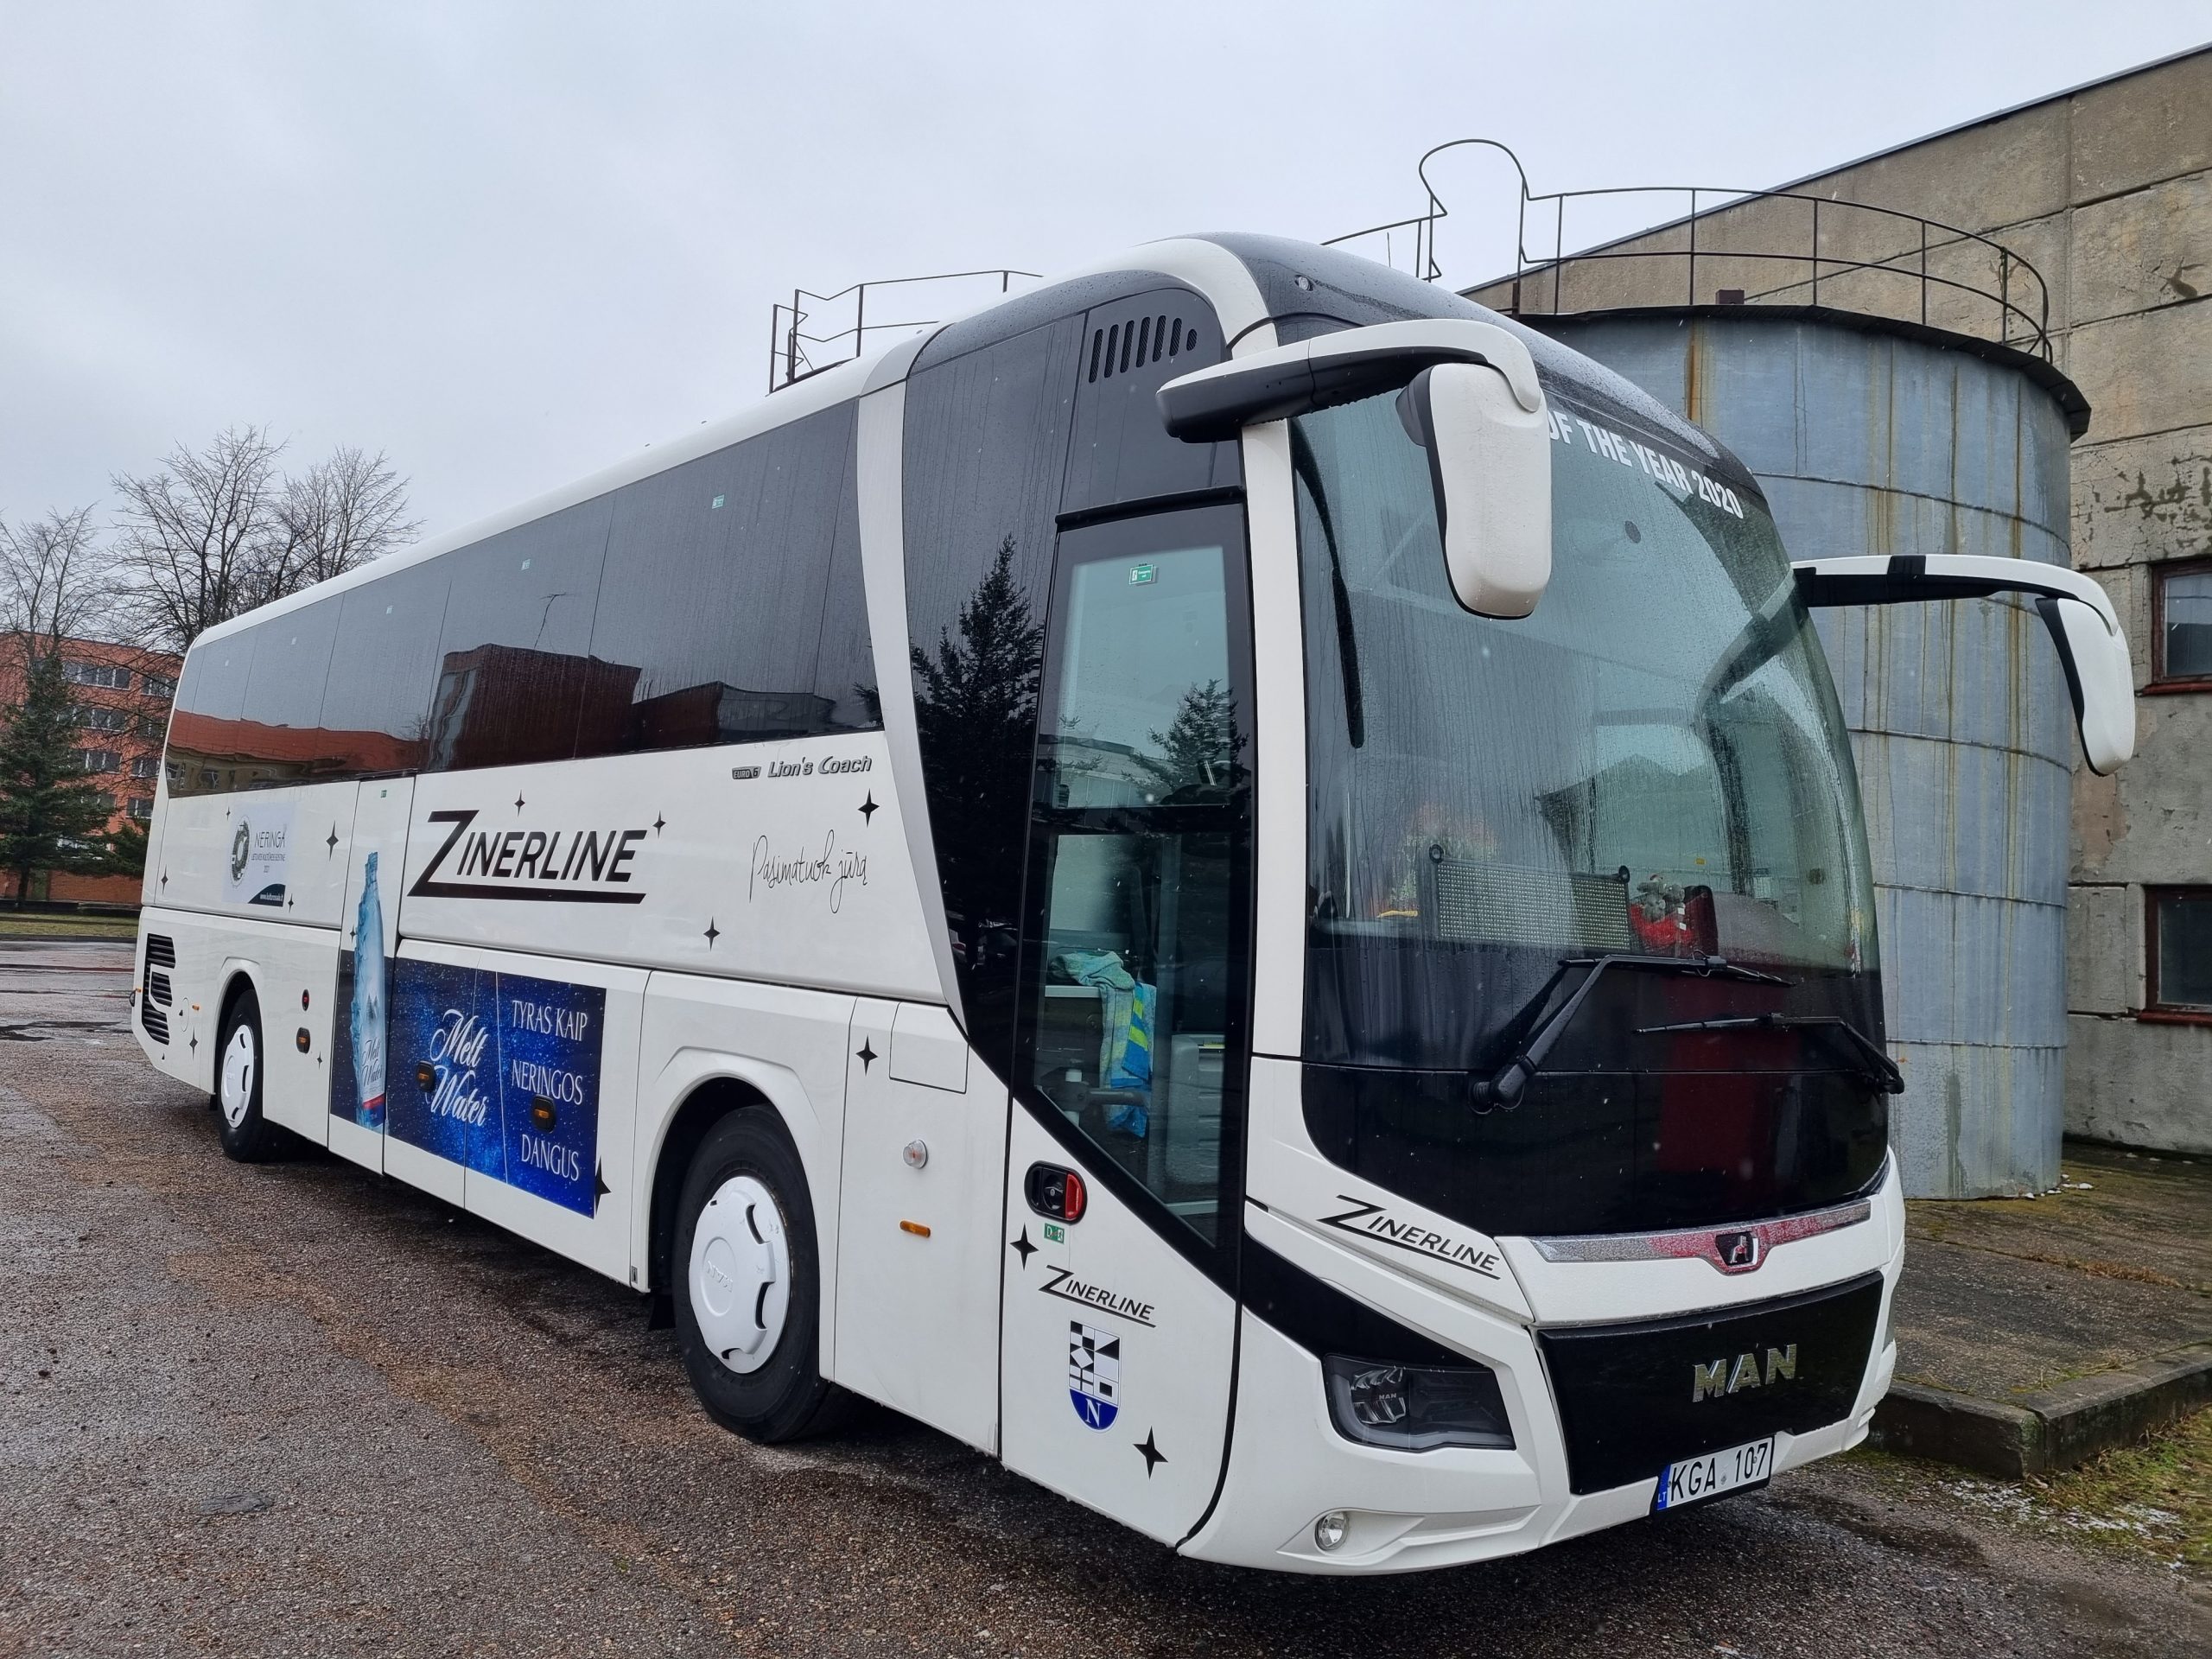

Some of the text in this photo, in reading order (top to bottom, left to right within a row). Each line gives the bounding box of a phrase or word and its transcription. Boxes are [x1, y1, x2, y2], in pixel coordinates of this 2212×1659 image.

[1575, 418, 1633, 467] THE
[1628, 439, 1694, 494] YEAR
[1691, 469, 1744, 519] 2020
[734, 755, 872, 779] EURO 6 Lion's Coach
[255, 830, 286, 849] NERINGA
[407, 809, 647, 904] ZINERLINE
[429, 1008, 490, 1069] Melt
[512, 1000, 588, 1042] TYRAS KAIP
[424, 1065, 490, 1128] Water
[512, 1058, 583, 1106] NERINGOS
[521, 1134, 580, 1182] DANGUS
[1318, 1194, 1502, 1281] ZINERLINE
[1038, 1264, 1157, 1328] ZINERLINE
[1378, 1392, 1397, 1401] MAN
[1691, 1343, 1797, 1403] MAN
[1085, 1397, 1101, 1427] N
[1657, 1441, 1769, 1503] LT KGA 107
